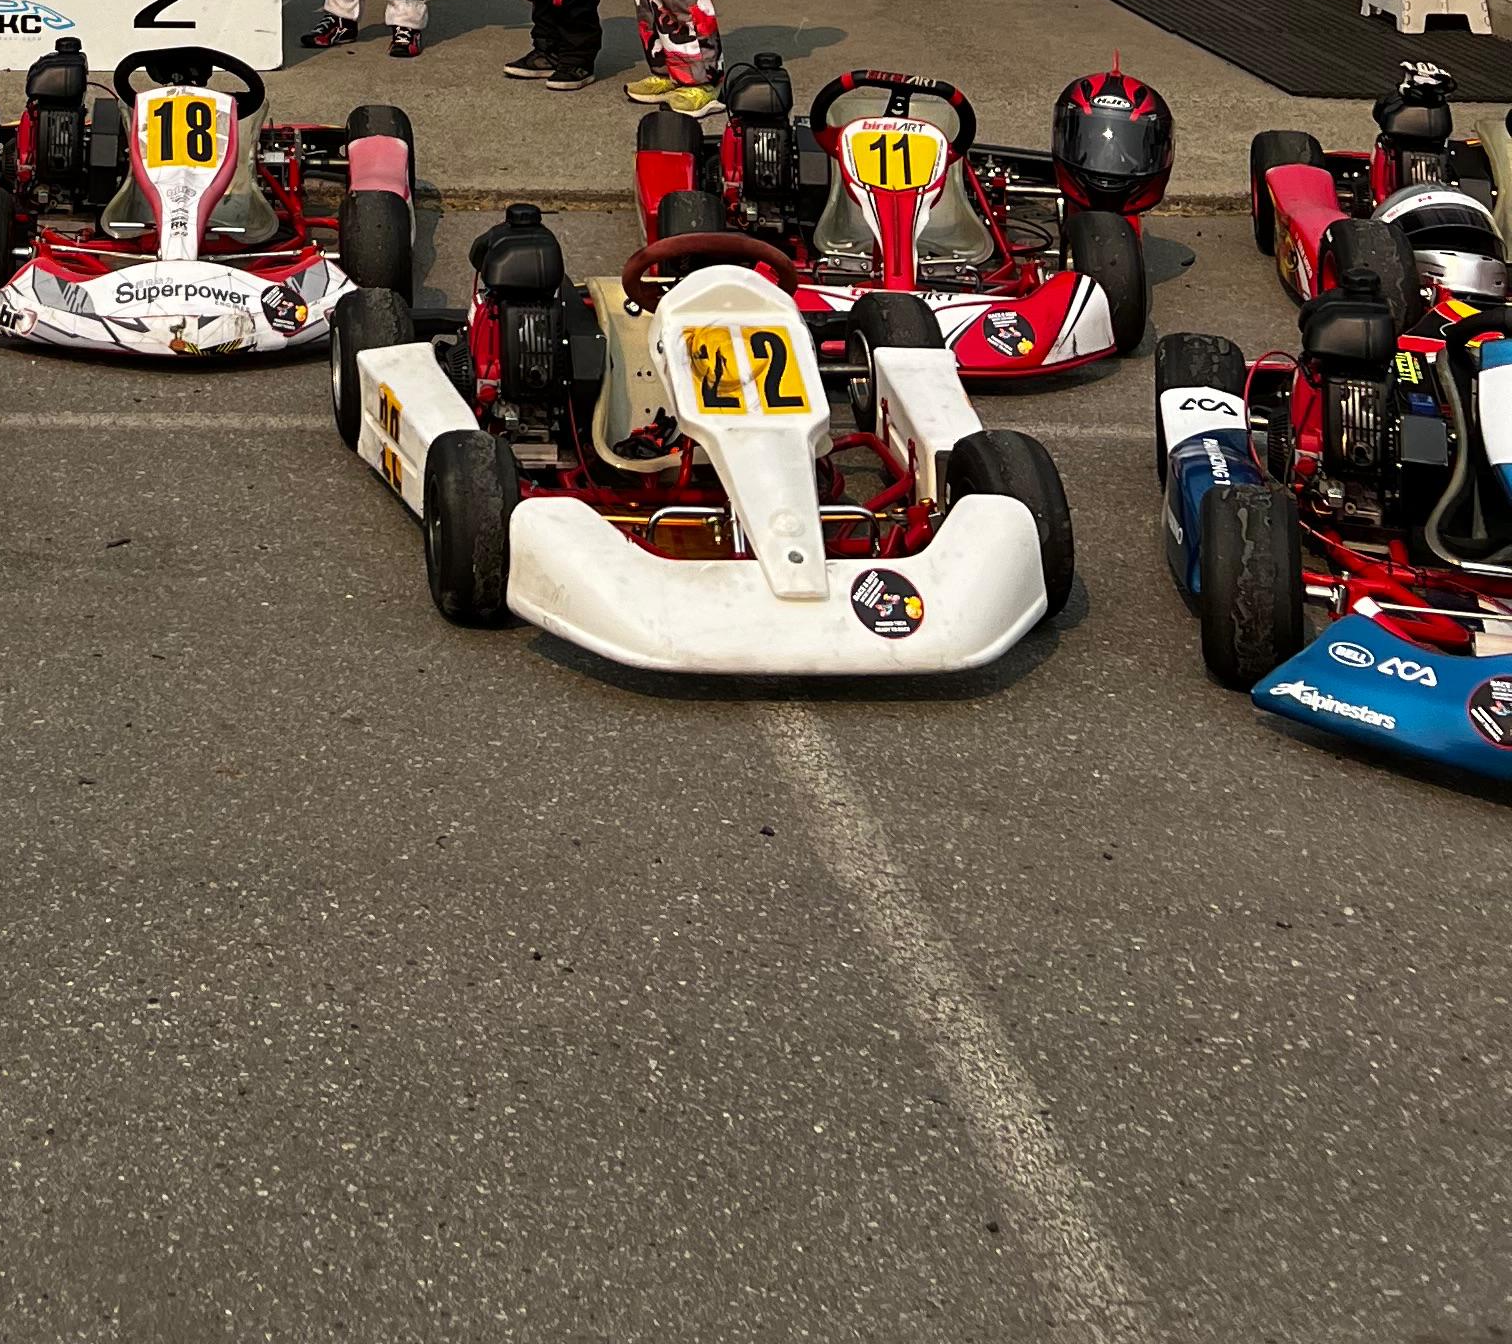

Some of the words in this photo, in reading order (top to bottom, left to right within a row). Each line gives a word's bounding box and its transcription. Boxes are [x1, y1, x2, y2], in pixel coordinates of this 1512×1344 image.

[153, 100, 213, 162] 18
[869, 133, 912, 185] 11
[115, 281, 251, 306] Superpower
[697, 331, 804, 408] 22
[1335, 645, 1367, 665] BELL
[1300, 689, 1396, 730] alpinestars
